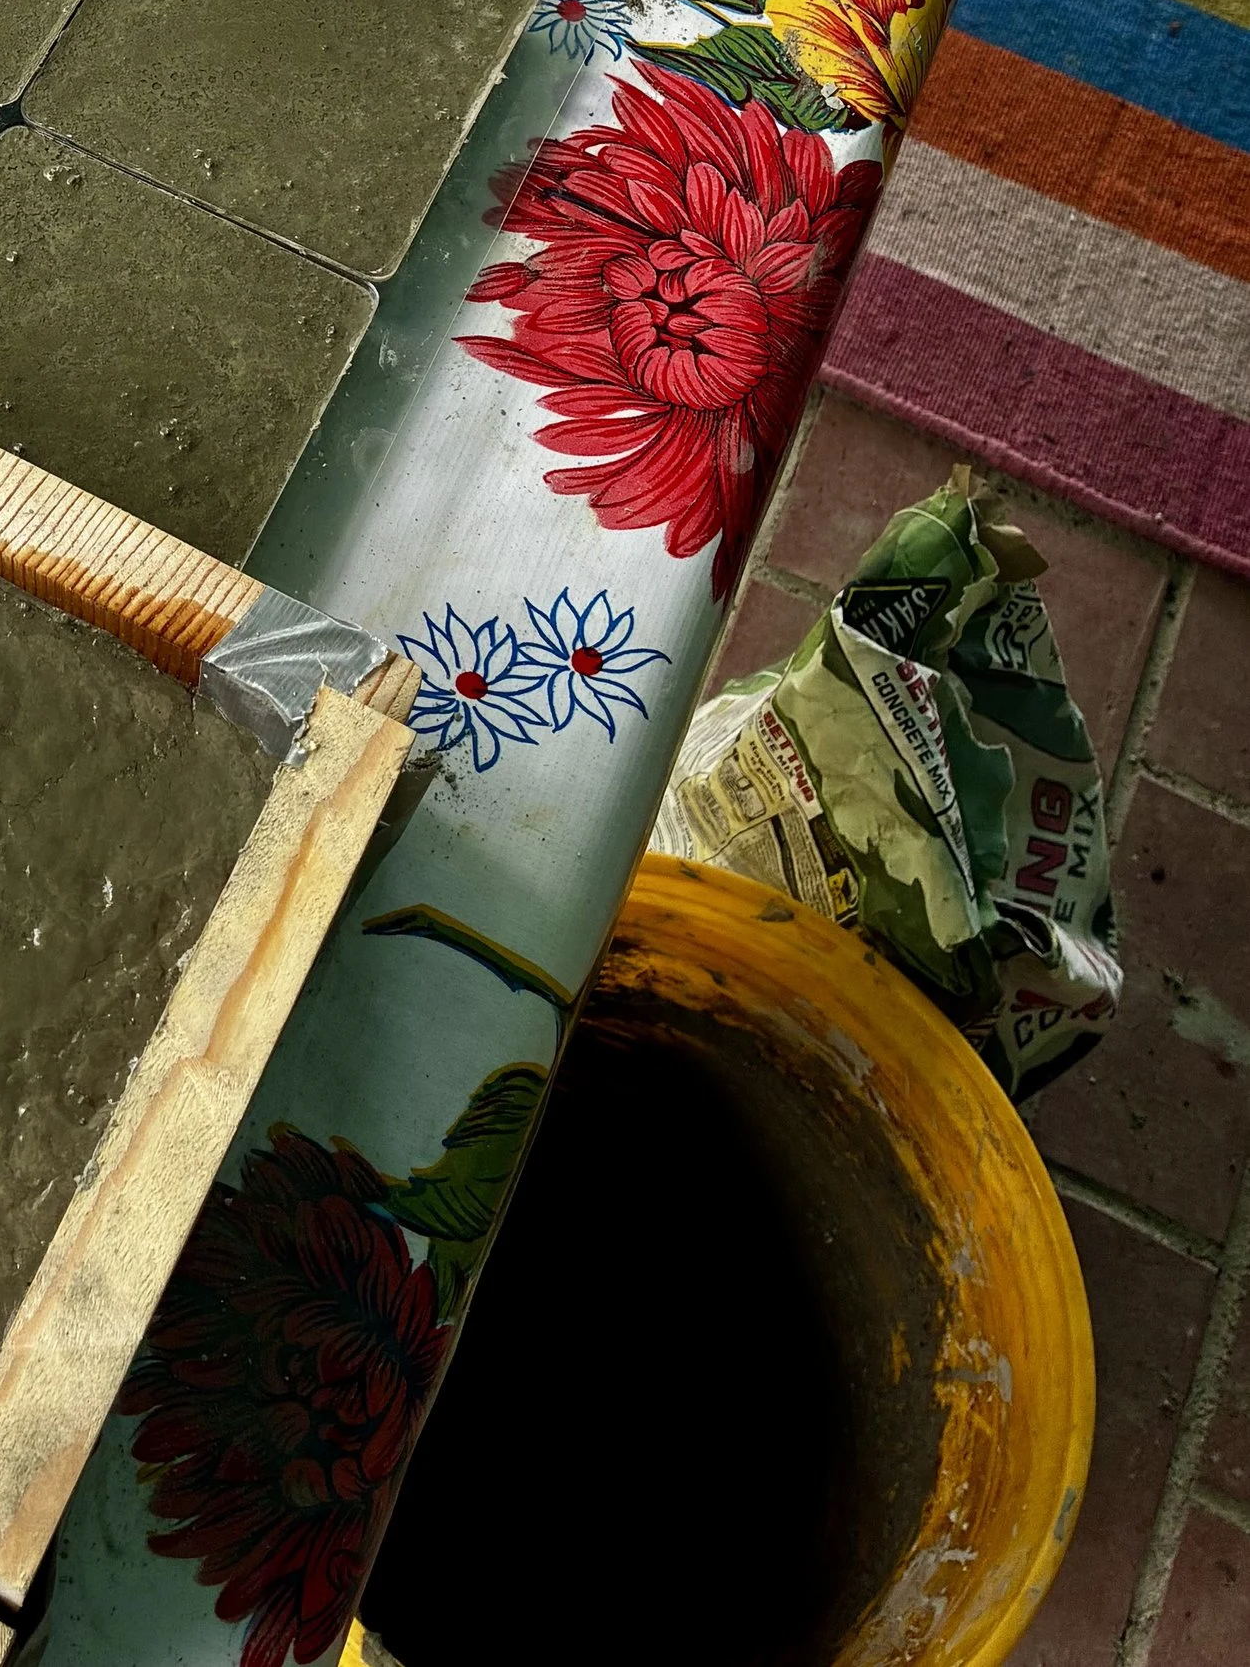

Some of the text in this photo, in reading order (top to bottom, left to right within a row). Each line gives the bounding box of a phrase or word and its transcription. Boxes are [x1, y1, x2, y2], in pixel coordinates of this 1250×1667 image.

[871, 671, 934, 765] CONCRETE
[927, 761, 953, 802] MIX
[1067, 792, 1100, 879] MIX
